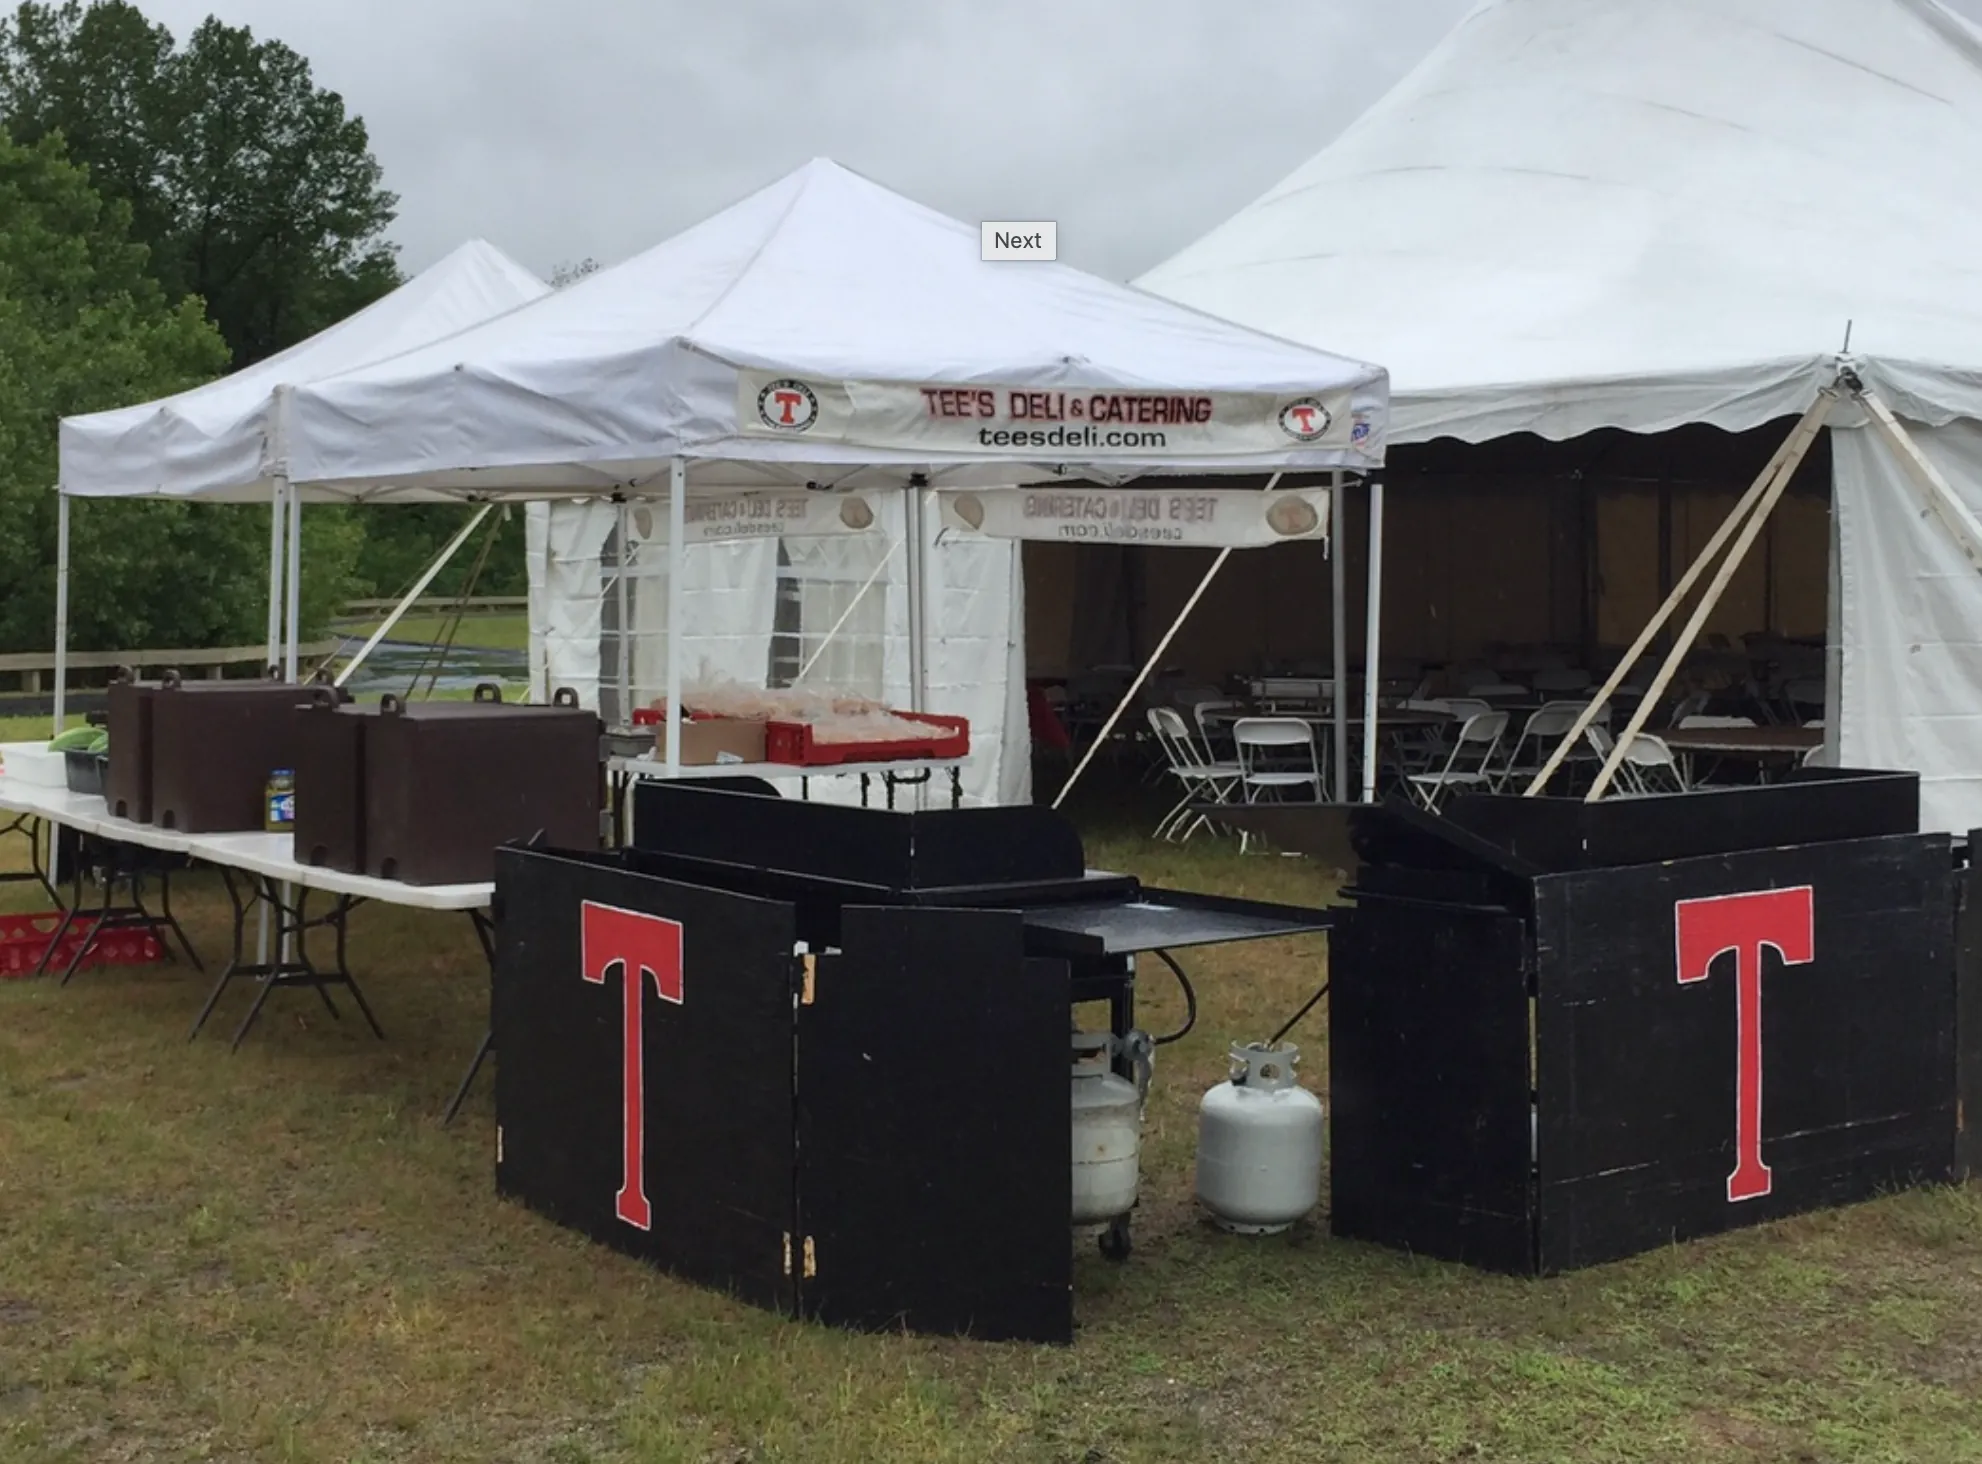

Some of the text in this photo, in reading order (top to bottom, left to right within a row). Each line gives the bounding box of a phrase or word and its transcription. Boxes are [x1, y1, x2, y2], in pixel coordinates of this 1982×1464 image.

[773, 391, 803, 425] T
[920, 387, 1213, 424] TEE'S DELI & CATERING
[1291, 406, 1316, 433] T
[978, 425, 1167, 448] teesdeli.com
[1674, 884, 1814, 1202] T
[581, 899, 684, 1232] T
